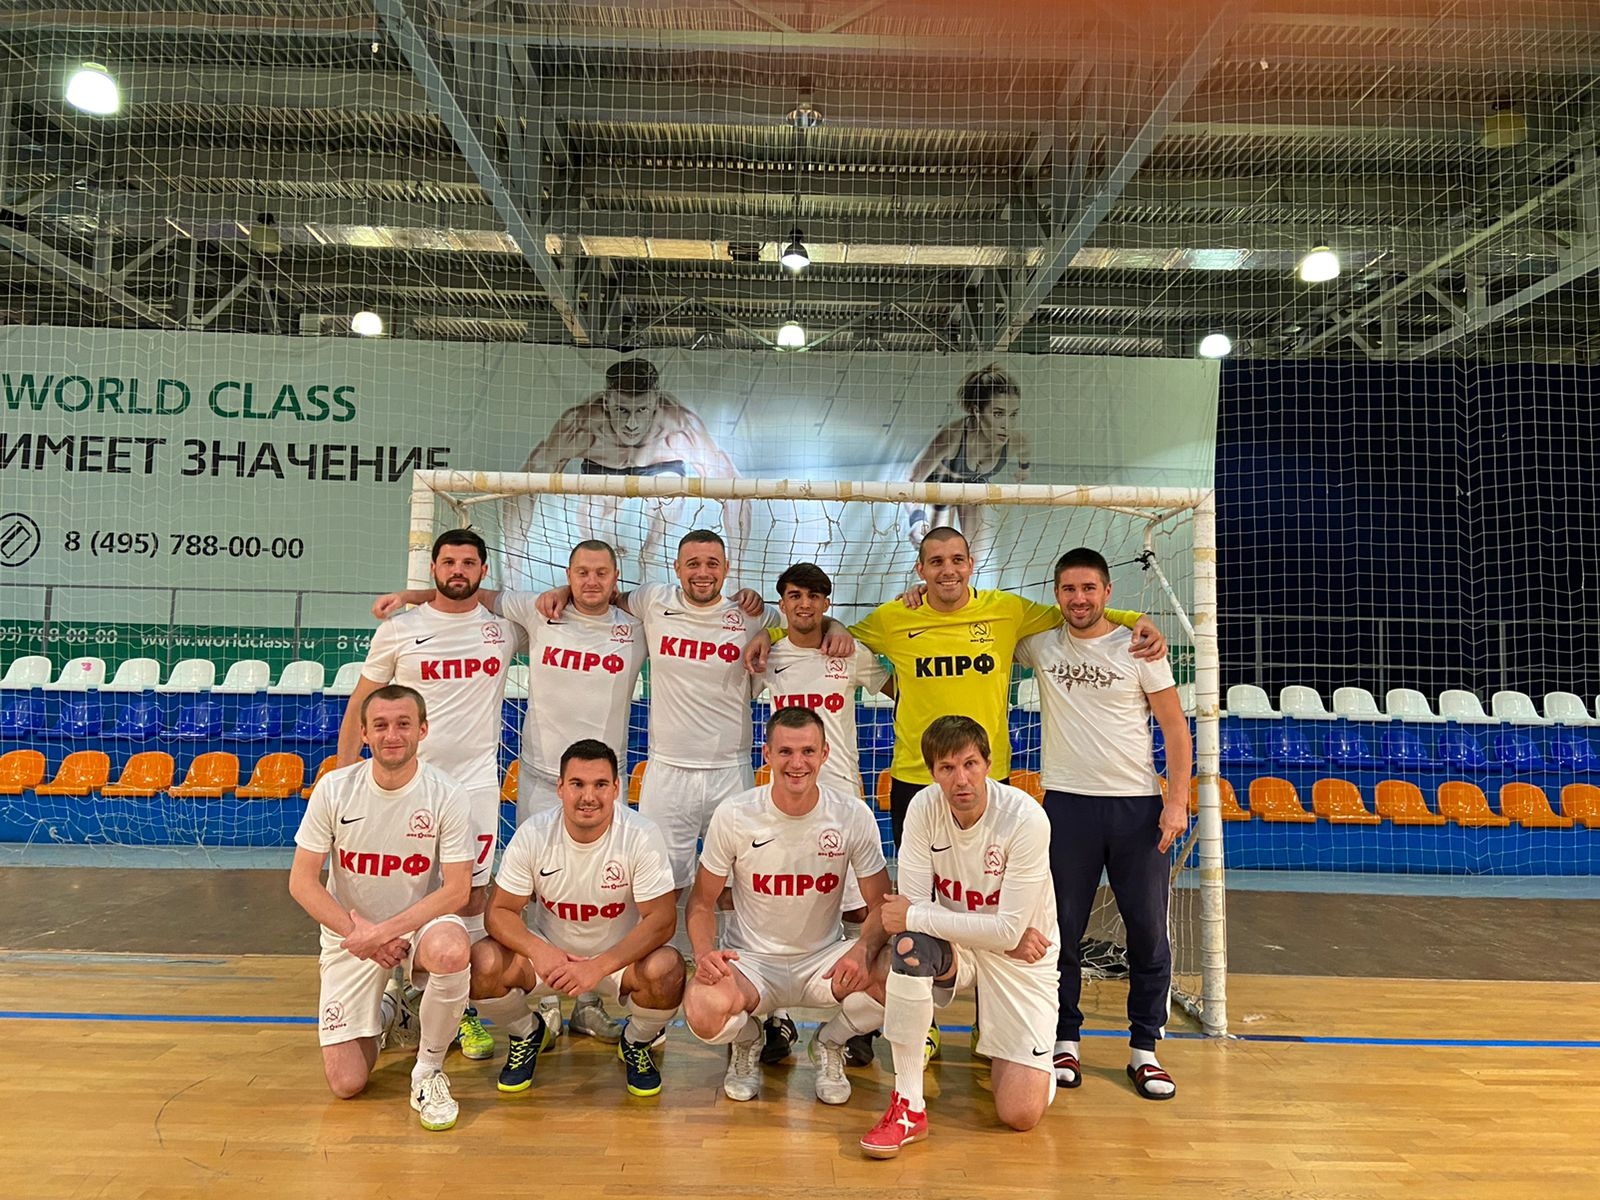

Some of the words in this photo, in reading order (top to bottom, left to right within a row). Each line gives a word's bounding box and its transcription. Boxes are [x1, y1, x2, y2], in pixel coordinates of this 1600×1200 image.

[2, 373, 191, 415] WORLD
[207, 381, 357, 422] CLASS
[0, 433, 167, 475] ИМЕЕТ
[180, 438, 452, 483] ЗНАЧЕНИЕ
[64, 530, 81, 553] 8
[90, 529, 160, 559] (495)
[169, 533, 304, 559] 788-00-00
[337, 635, 348, 650] 8
[659, 636, 741, 663] КПРФ
[420, 656, 501, 681] КПРФ
[542, 646, 624, 674] КПРФ
[915, 653, 995, 678] КПРФ
[1055, 661, 1110, 682] BOSS
[773, 692, 845, 713] КПРФ
[339, 848, 431, 877] КПРФ
[477, 834, 494, 865] 7
[752, 872, 840, 897] КПРФ
[540, 895, 626, 922] КПРФ
